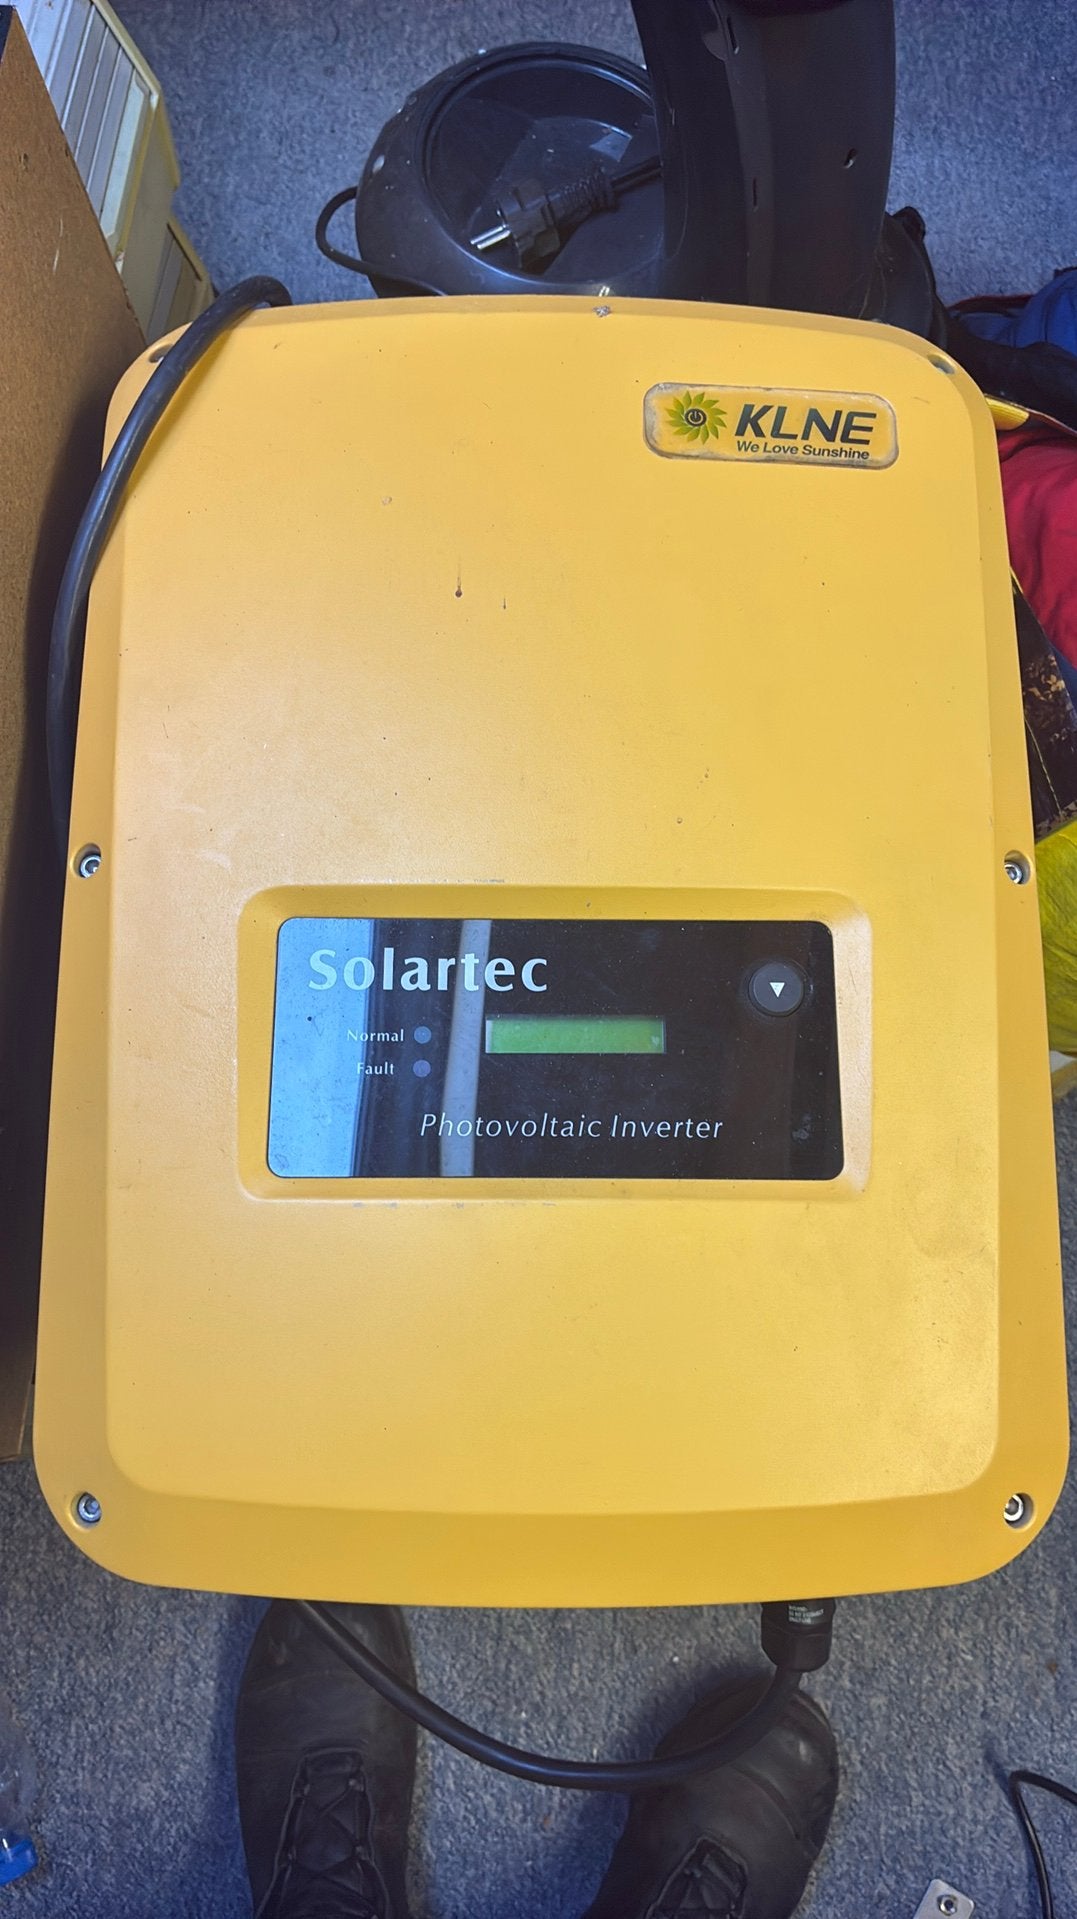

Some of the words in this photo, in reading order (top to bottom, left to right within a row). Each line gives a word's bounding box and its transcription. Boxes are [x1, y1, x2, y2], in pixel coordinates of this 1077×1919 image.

[735, 403, 877, 445] KLNE
[736, 440, 760, 452] We
[763, 442, 799, 456] Love
[802, 444, 870, 460] Sunshine
[308, 947, 548, 992] Solartec
[346, 1029, 405, 1042] Normal
[356, 1062, 395, 1075] Fault
[420, 1112, 602, 1138] Photovoltaic
[611, 1115, 724, 1139] Inverter
